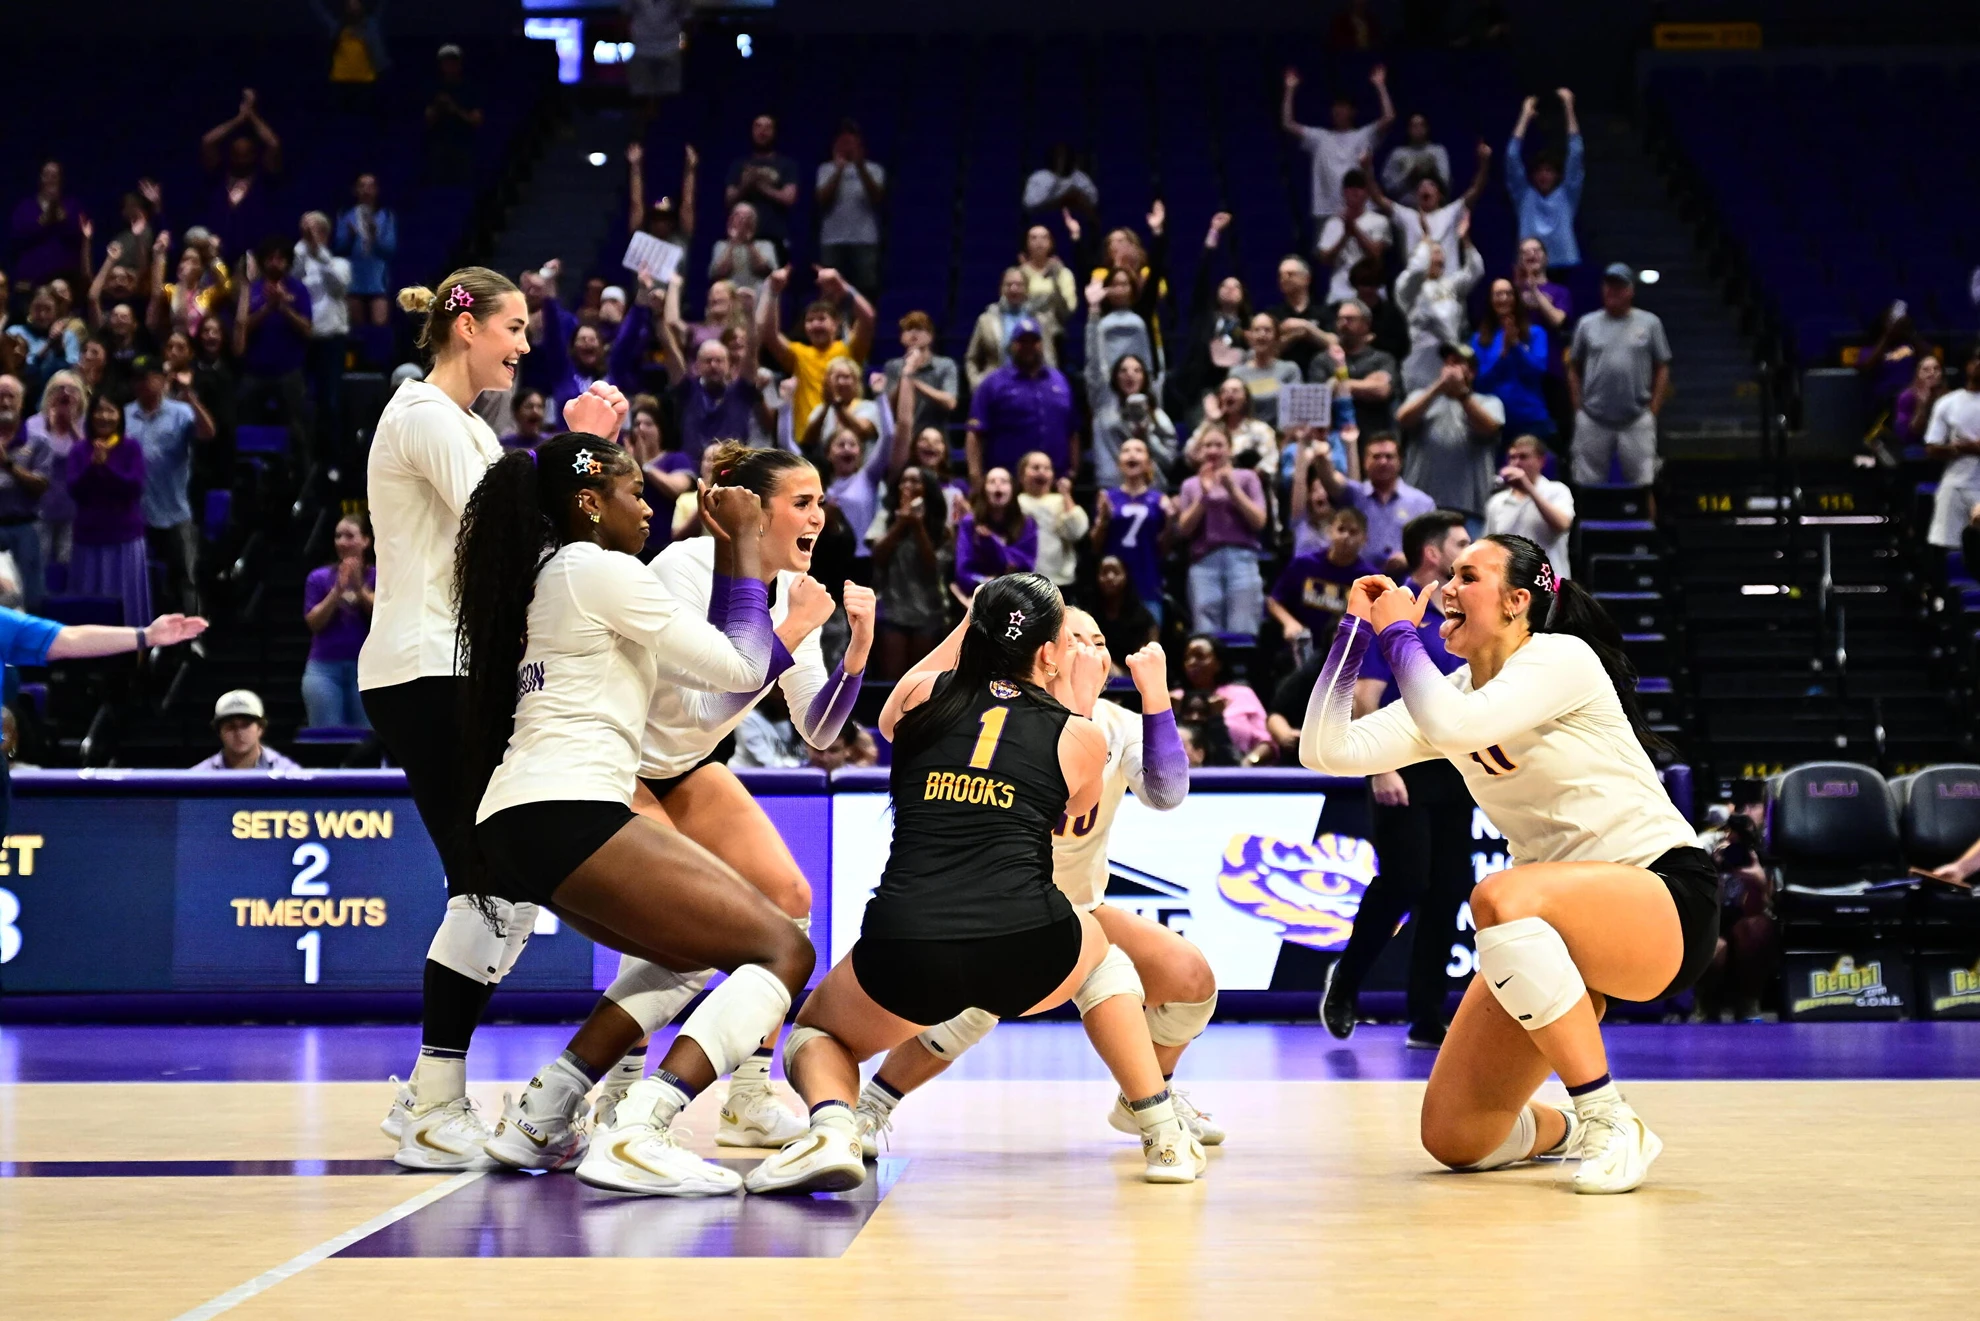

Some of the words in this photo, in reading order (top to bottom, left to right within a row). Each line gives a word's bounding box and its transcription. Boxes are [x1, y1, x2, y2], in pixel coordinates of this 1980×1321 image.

[1120, 503, 1150, 548] 7
[968, 705, 1010, 770] 1
[923, 771, 1015, 809] BROOKS
[1807, 780, 1859, 798] LSU
[231, 809, 309, 839] SETS
[314, 809, 394, 839] WON
[291, 842, 330, 896] 2
[230, 897, 387, 927] TIMEOUTS
[296, 929, 321, 985] 1
[516, 1118, 538, 1136] LSU
